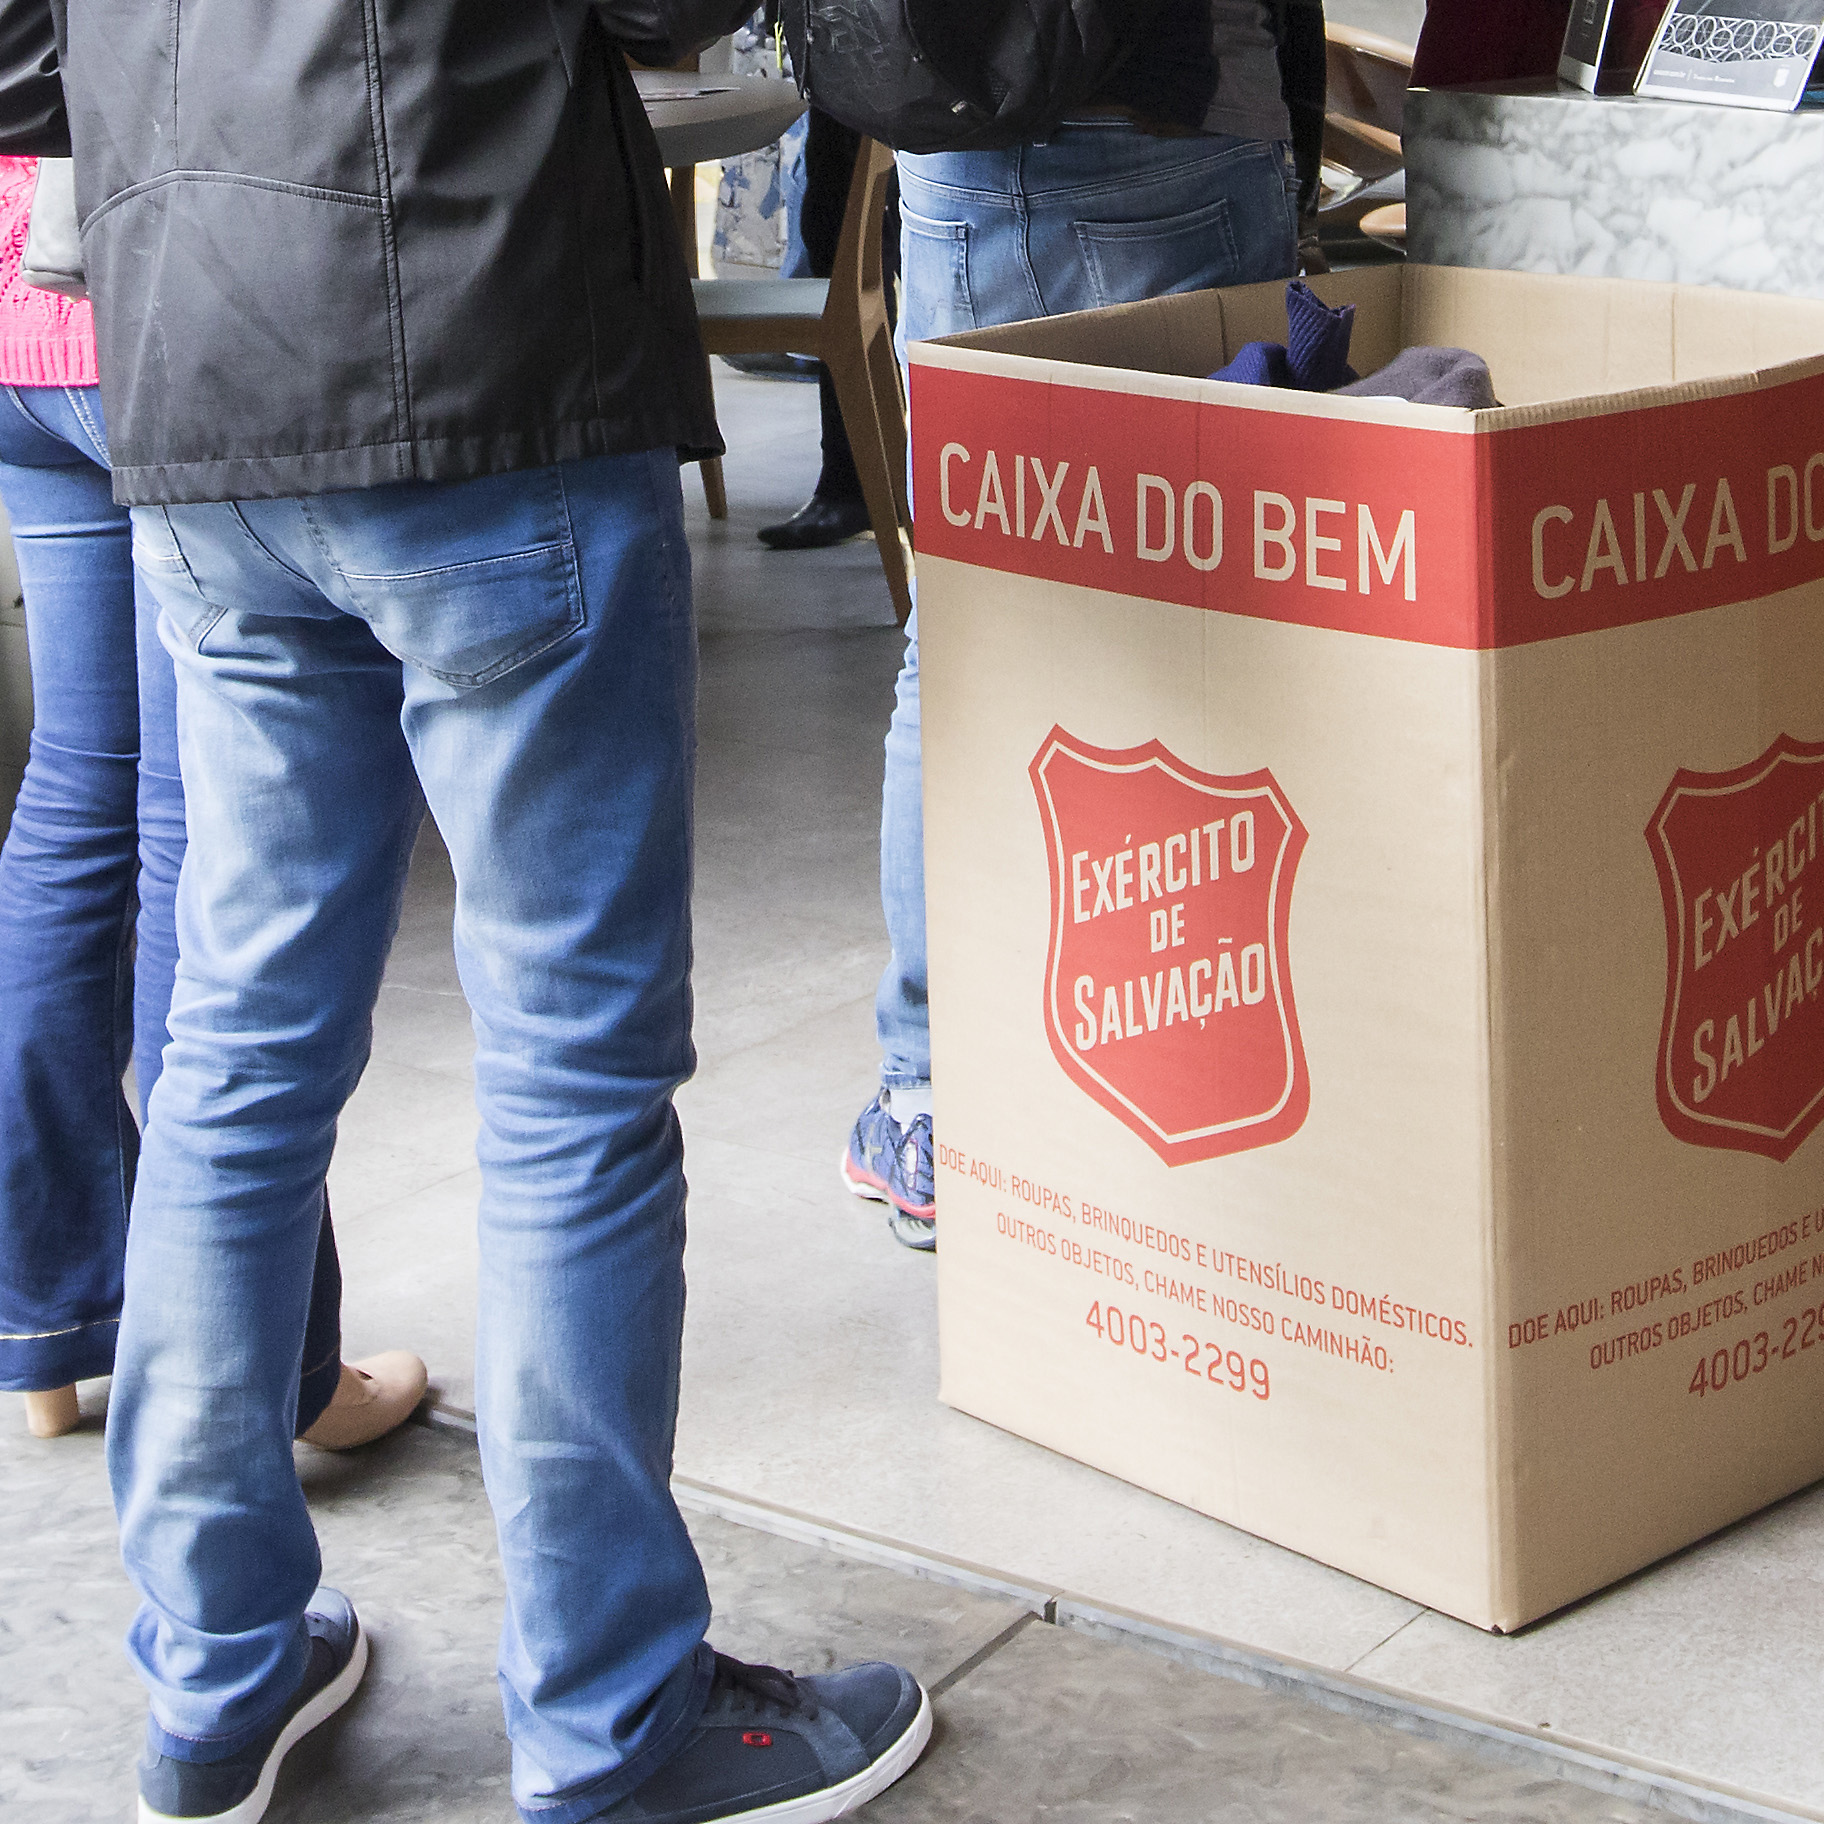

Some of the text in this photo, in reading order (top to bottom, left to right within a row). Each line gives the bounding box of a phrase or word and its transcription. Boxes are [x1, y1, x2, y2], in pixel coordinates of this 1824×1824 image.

[940, 442, 1416, 601] CAIXA DO BEM
[1531, 478, 1747, 599] CAIXA
[1072, 810, 1255, 924] EXÉRCITO
[1773, 885, 1803, 955] DE
[1150, 903, 1185, 954] DE
[1074, 938, 1266, 1051] SALVAÇÃO
[939, 1143, 1474, 1348] DOE AQUI: ROUPAS, BRINQUEDOS E UTENSÍLIOS DOMÉSTICOS.
[997, 1212, 1394, 1374] OUTROS OBJETOS, CHAME NOSSO CAMINHÃO:
[1508, 1313, 1549, 1349] DOE
[1554, 1297, 1605, 1335] AQUI:
[1611, 1266, 1687, 1316] ROUPAS,
[1692, 1222, 1798, 1286] BRINQUEDOS
[1801, 1214, 1812, 1240] E
[1086, 1299, 1270, 1401] 4003-2299
[1589, 1322, 1663, 1370] OUTROS
[1667, 1289, 1748, 1340] OBJETOS,
[1753, 1260, 1808, 1306] CHAME
